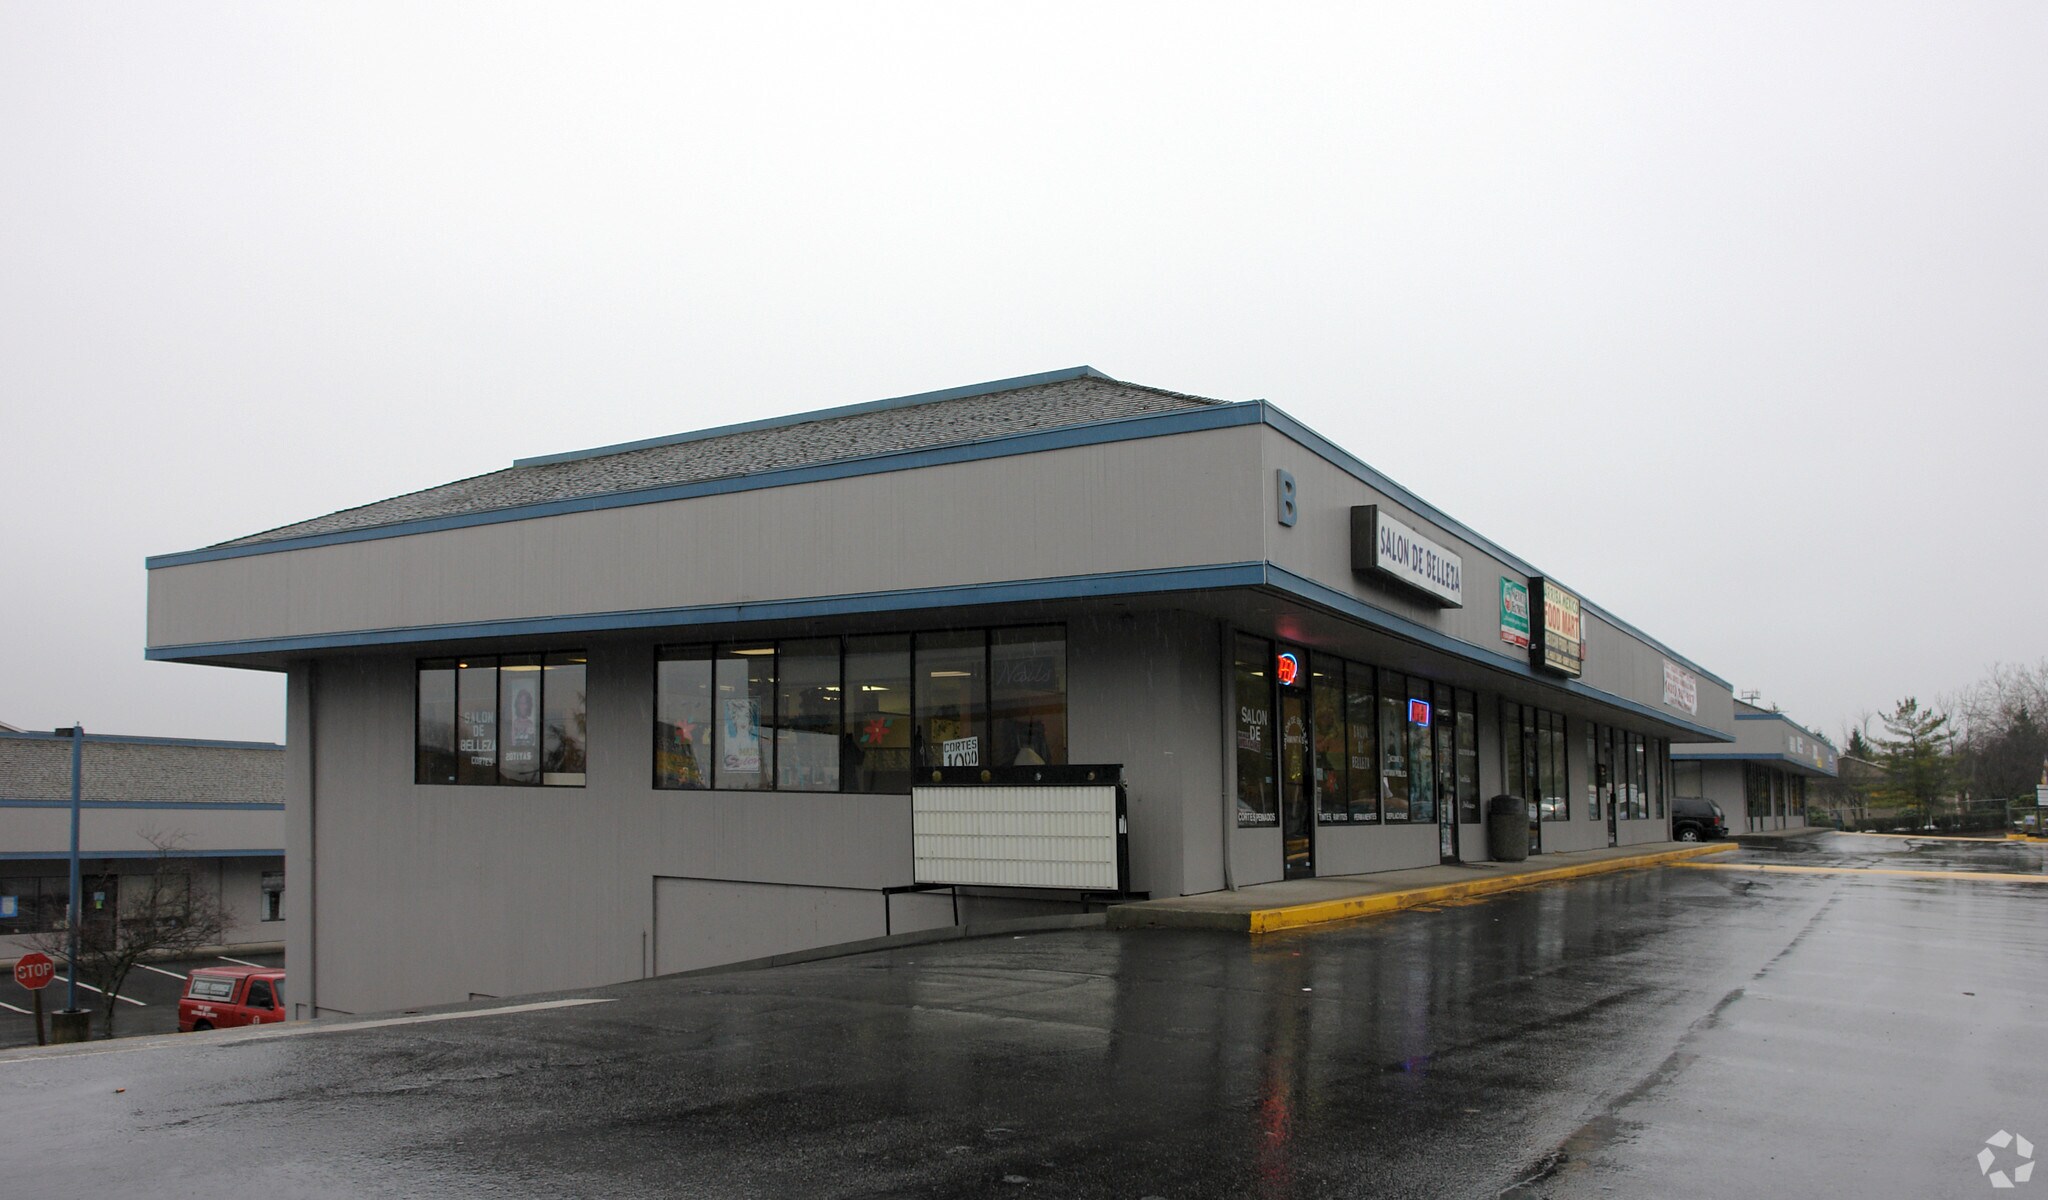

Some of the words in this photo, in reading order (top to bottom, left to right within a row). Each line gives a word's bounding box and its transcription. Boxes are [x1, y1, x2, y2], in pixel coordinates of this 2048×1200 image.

[1277, 469, 1297, 527] B
[1381, 526, 1410, 567] SALON
[1412, 544, 1424, 574] DE
[1427, 550, 1460, 593] BELLEZA
[1544, 601, 1560, 630] FOOD
[1562, 610, 1579, 640] MART
[464, 711, 494, 724] SALON
[1241, 706, 1268, 726] SALON
[473, 725, 485, 737] DE
[1249, 726, 1261, 741] DE
[460, 739, 496, 752] BELLEZA
[944, 739, 977, 753] CORTES
[18, 962, 52, 979] STOP
